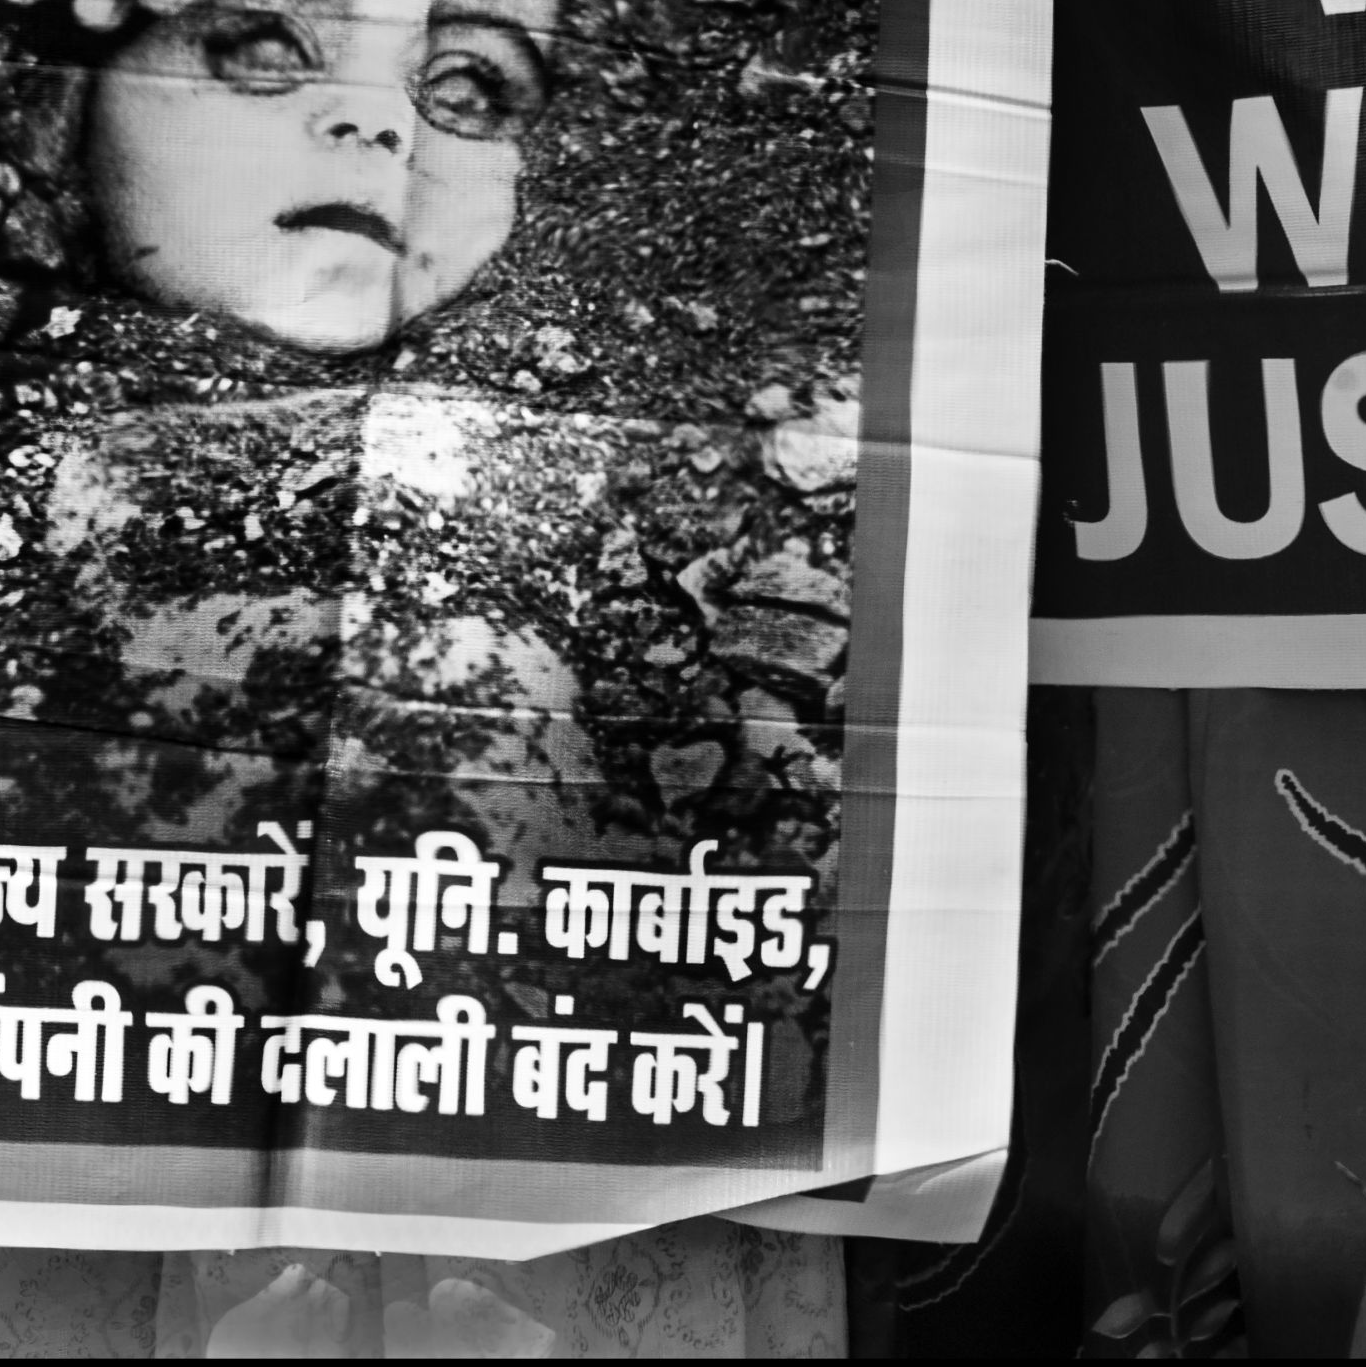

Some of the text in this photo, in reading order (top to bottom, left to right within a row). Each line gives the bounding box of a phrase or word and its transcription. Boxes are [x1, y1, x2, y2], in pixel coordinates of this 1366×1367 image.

[85, 820, 327, 968] सरकारें,
[355, 831, 518, 989] यूनि.
[543, 840, 830, 990] कार्बाइड,
[146, 985, 245, 1105] की
[261, 994, 496, 1116] दलाली
[512, 995, 618, 1122] बंद
